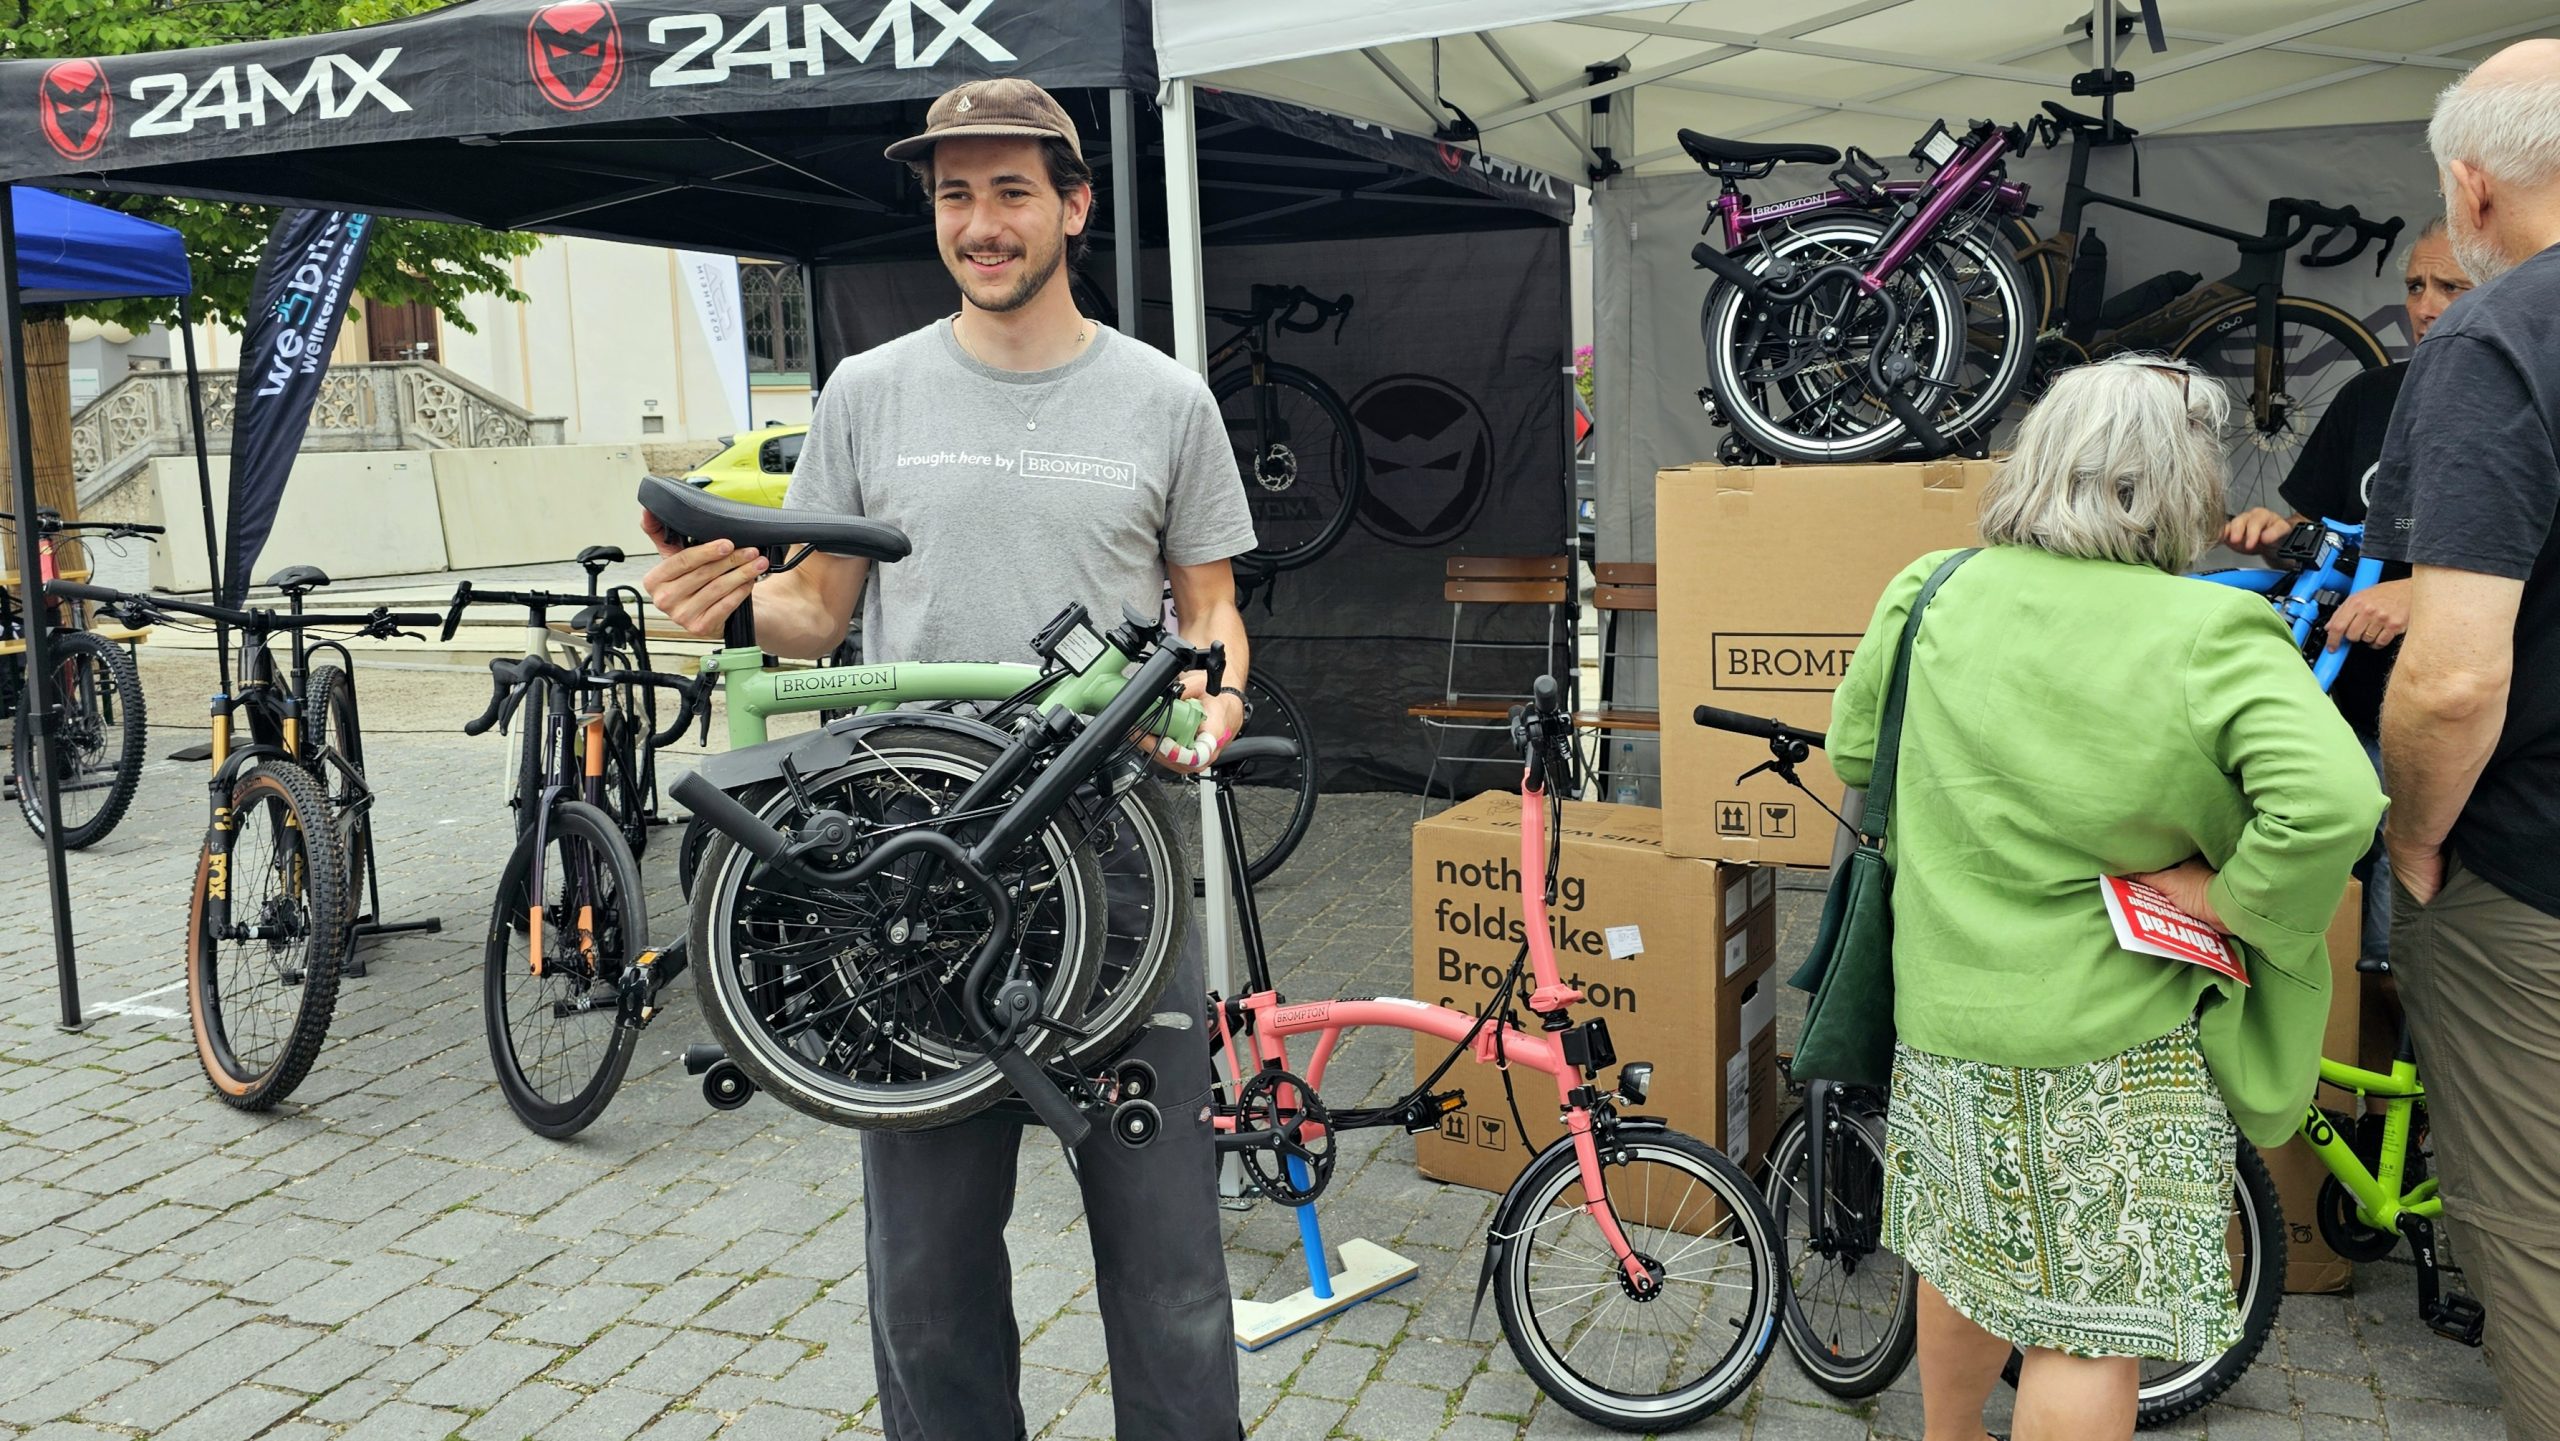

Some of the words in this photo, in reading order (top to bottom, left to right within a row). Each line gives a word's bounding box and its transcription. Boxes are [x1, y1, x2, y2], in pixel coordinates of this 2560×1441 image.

[648, 0, 1018, 87] 24MX
[129, 47, 414, 138] 24MX
[1756, 194, 1821, 215] BROMPTON
[897, 451, 957, 467] brought
[957, 451, 991, 466] here
[995, 454, 1014, 471] by
[1028, 457, 1129, 482] BROMPTON
[783, 671, 888, 693] BROMPTON
[1600, 833, 1663, 848] THIS
[2134, 909, 2231, 965] Fahrrad
[1277, 1006, 1325, 1023] BROMPTON
